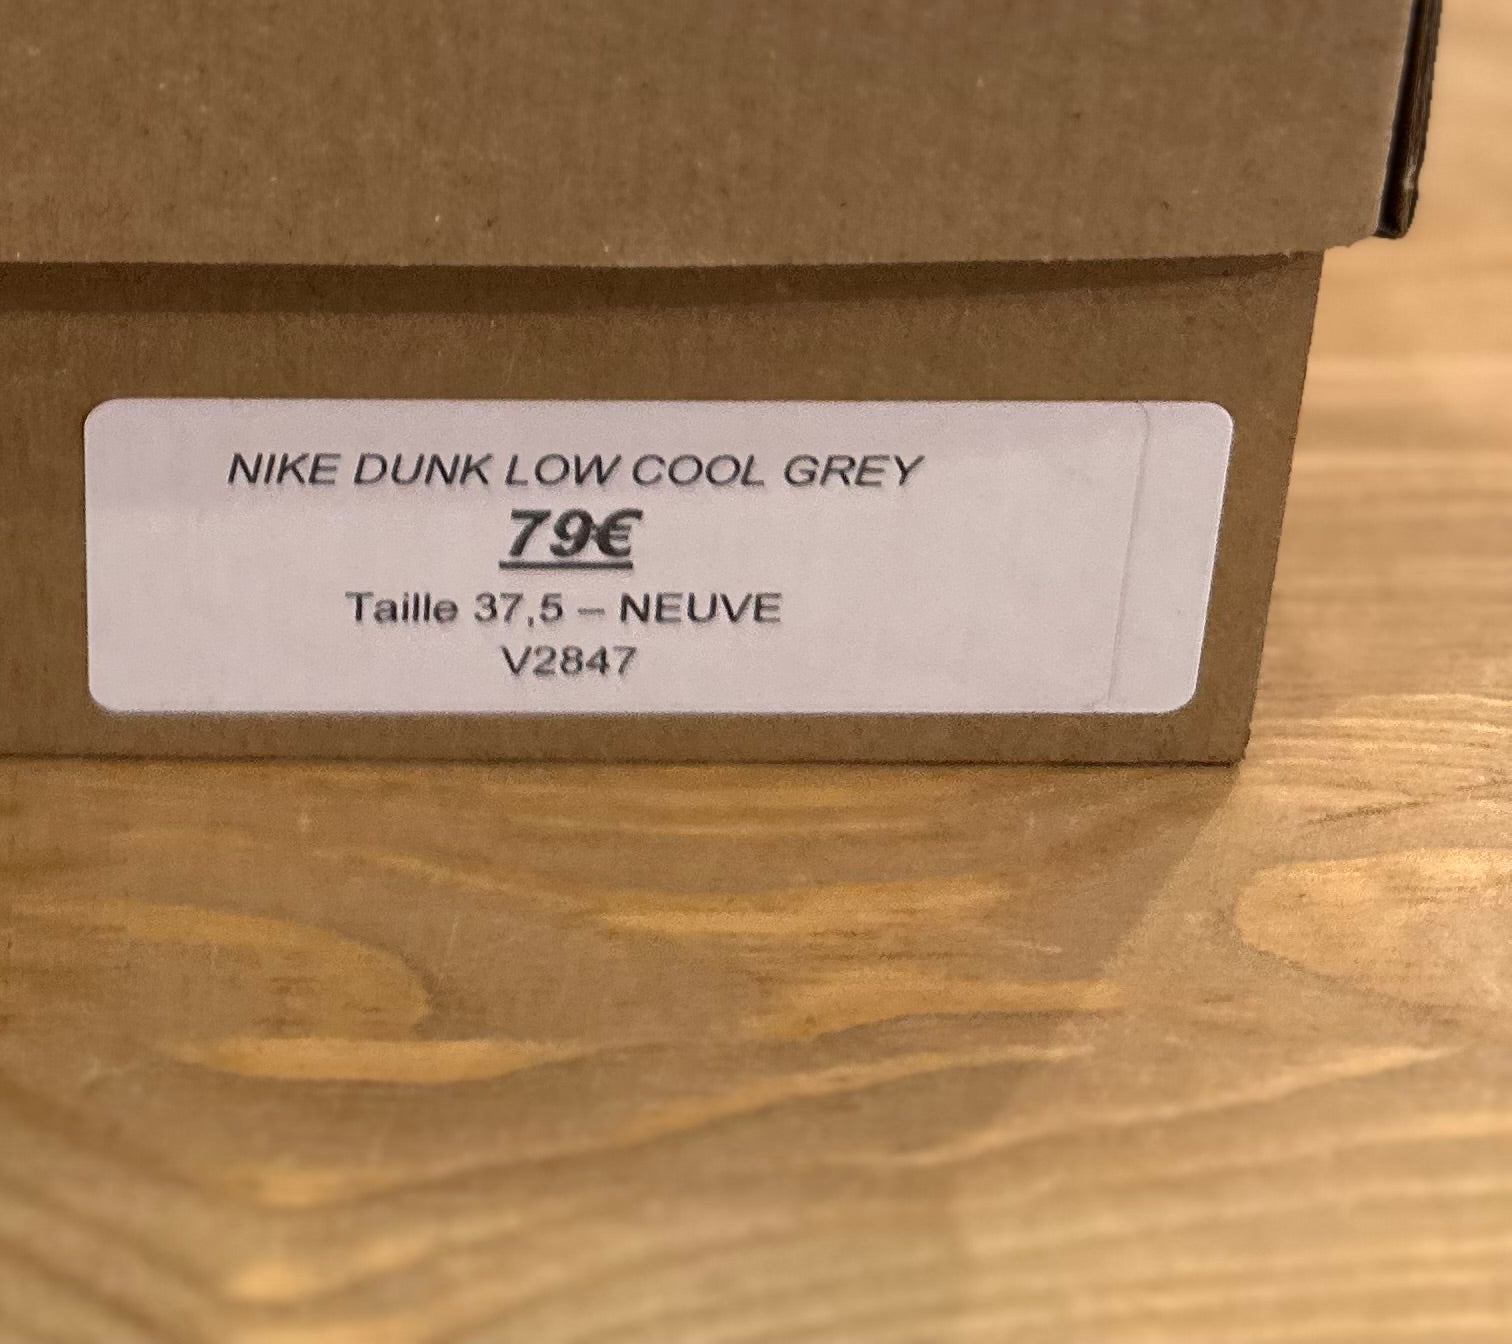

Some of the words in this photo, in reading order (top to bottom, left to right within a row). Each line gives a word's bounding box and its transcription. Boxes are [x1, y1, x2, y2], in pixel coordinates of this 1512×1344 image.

[227, 452, 341, 486] NIKE
[353, 452, 493, 486] DUNK
[504, 453, 622, 487] LOW
[631, 453, 765, 488] COOL
[783, 454, 926, 488] GREY
[506, 507, 643, 560] 79€
[344, 591, 459, 624] Taille
[473, 591, 564, 628] 37,5
[619, 591, 783, 624] NEUVE
[499, 644, 638, 676] V2847
